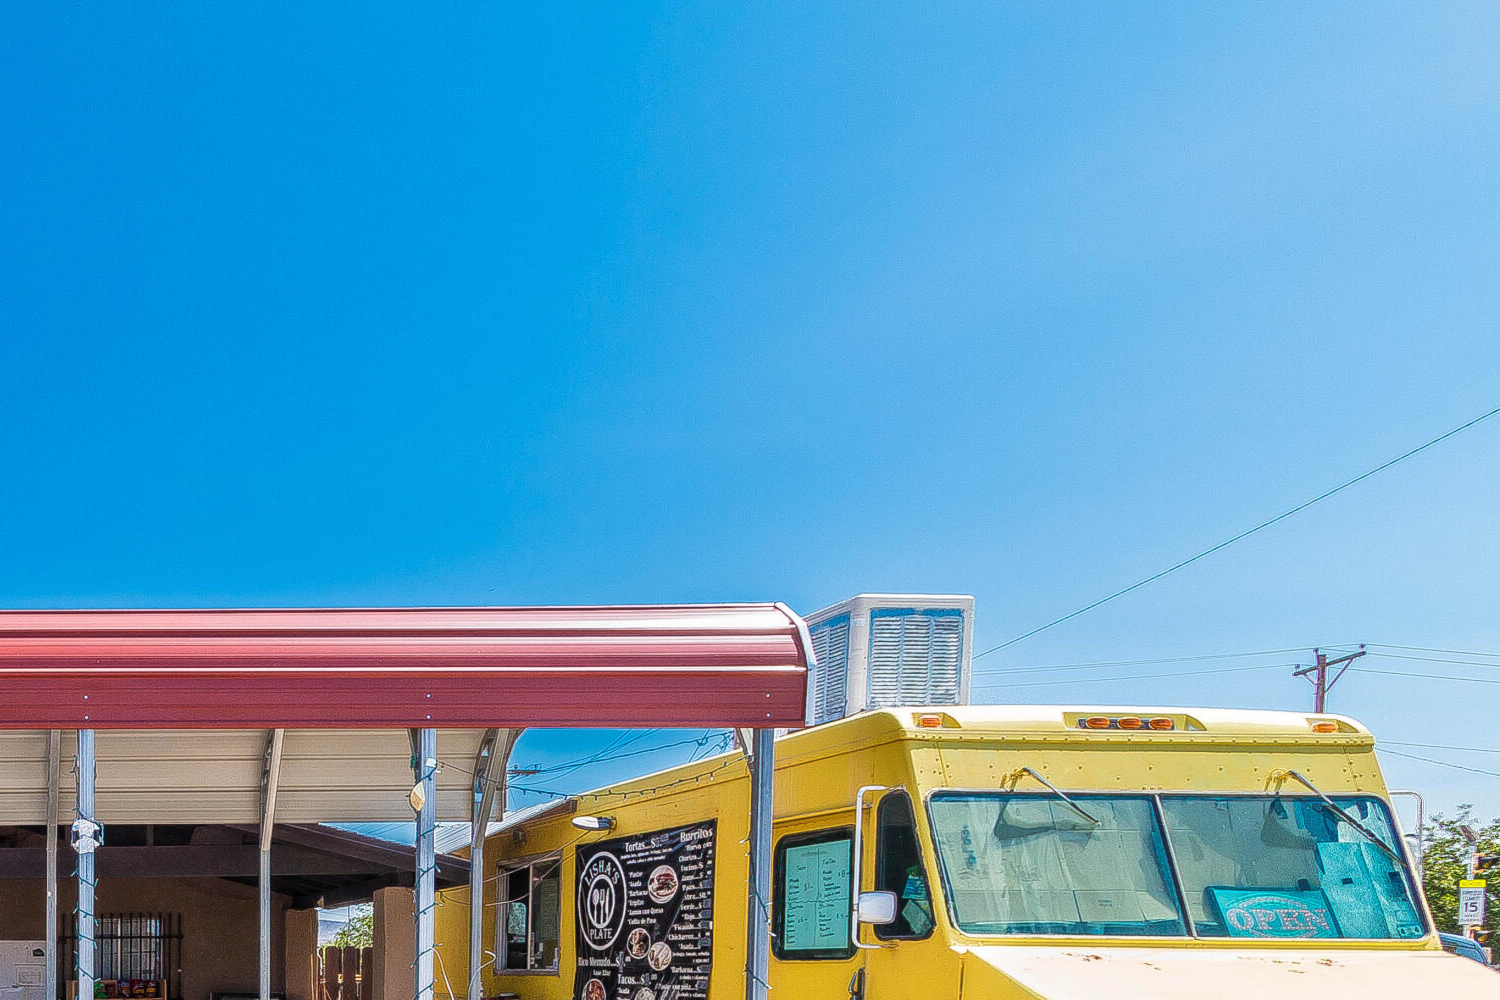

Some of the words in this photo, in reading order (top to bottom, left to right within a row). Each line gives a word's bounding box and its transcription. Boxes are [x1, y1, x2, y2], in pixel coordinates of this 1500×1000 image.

[680, 828, 713, 842] Burritos
[585, 860, 620, 886] LISHA'S
[1464, 901, 1478, 913] 15
[1226, 907, 1330, 931] OPEN
[590, 928, 613, 941] PLATE
